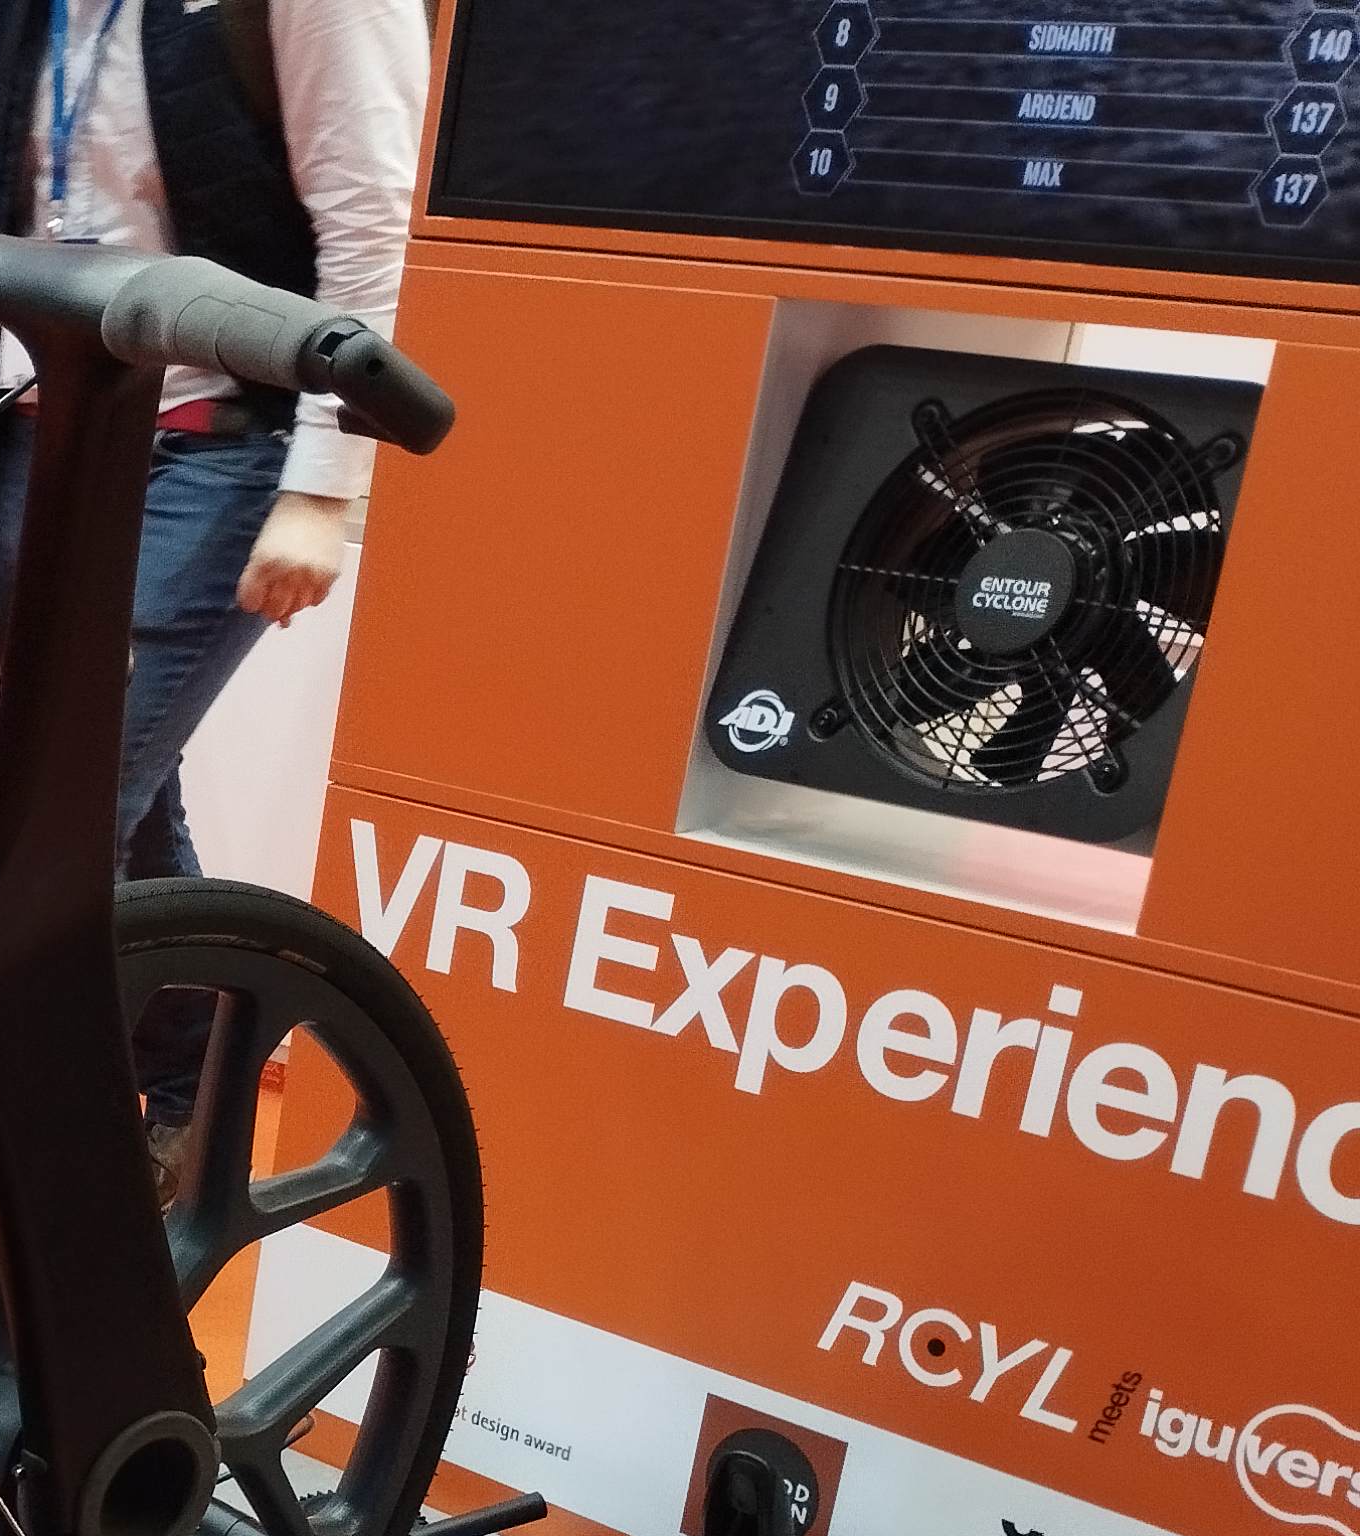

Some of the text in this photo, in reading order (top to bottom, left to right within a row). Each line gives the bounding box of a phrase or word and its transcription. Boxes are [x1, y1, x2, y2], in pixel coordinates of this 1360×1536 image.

[835, 18, 1353, 62] 8 SIDHARTH 140
[824, 83, 1335, 134] 9 ARGJEND 137
[809, 148, 1318, 204] 10 MAX 137
[972, 592, 1049, 613] CYCLONE
[980, 576, 1052, 597] ENTOUR
[350, 818, 531, 993] VR
[816, 1281, 1078, 1433] RCYL
[1088, 1371, 1143, 1445] meets
[471, 1411, 519, 1441] design
[524, 1434, 571, 1461] award
